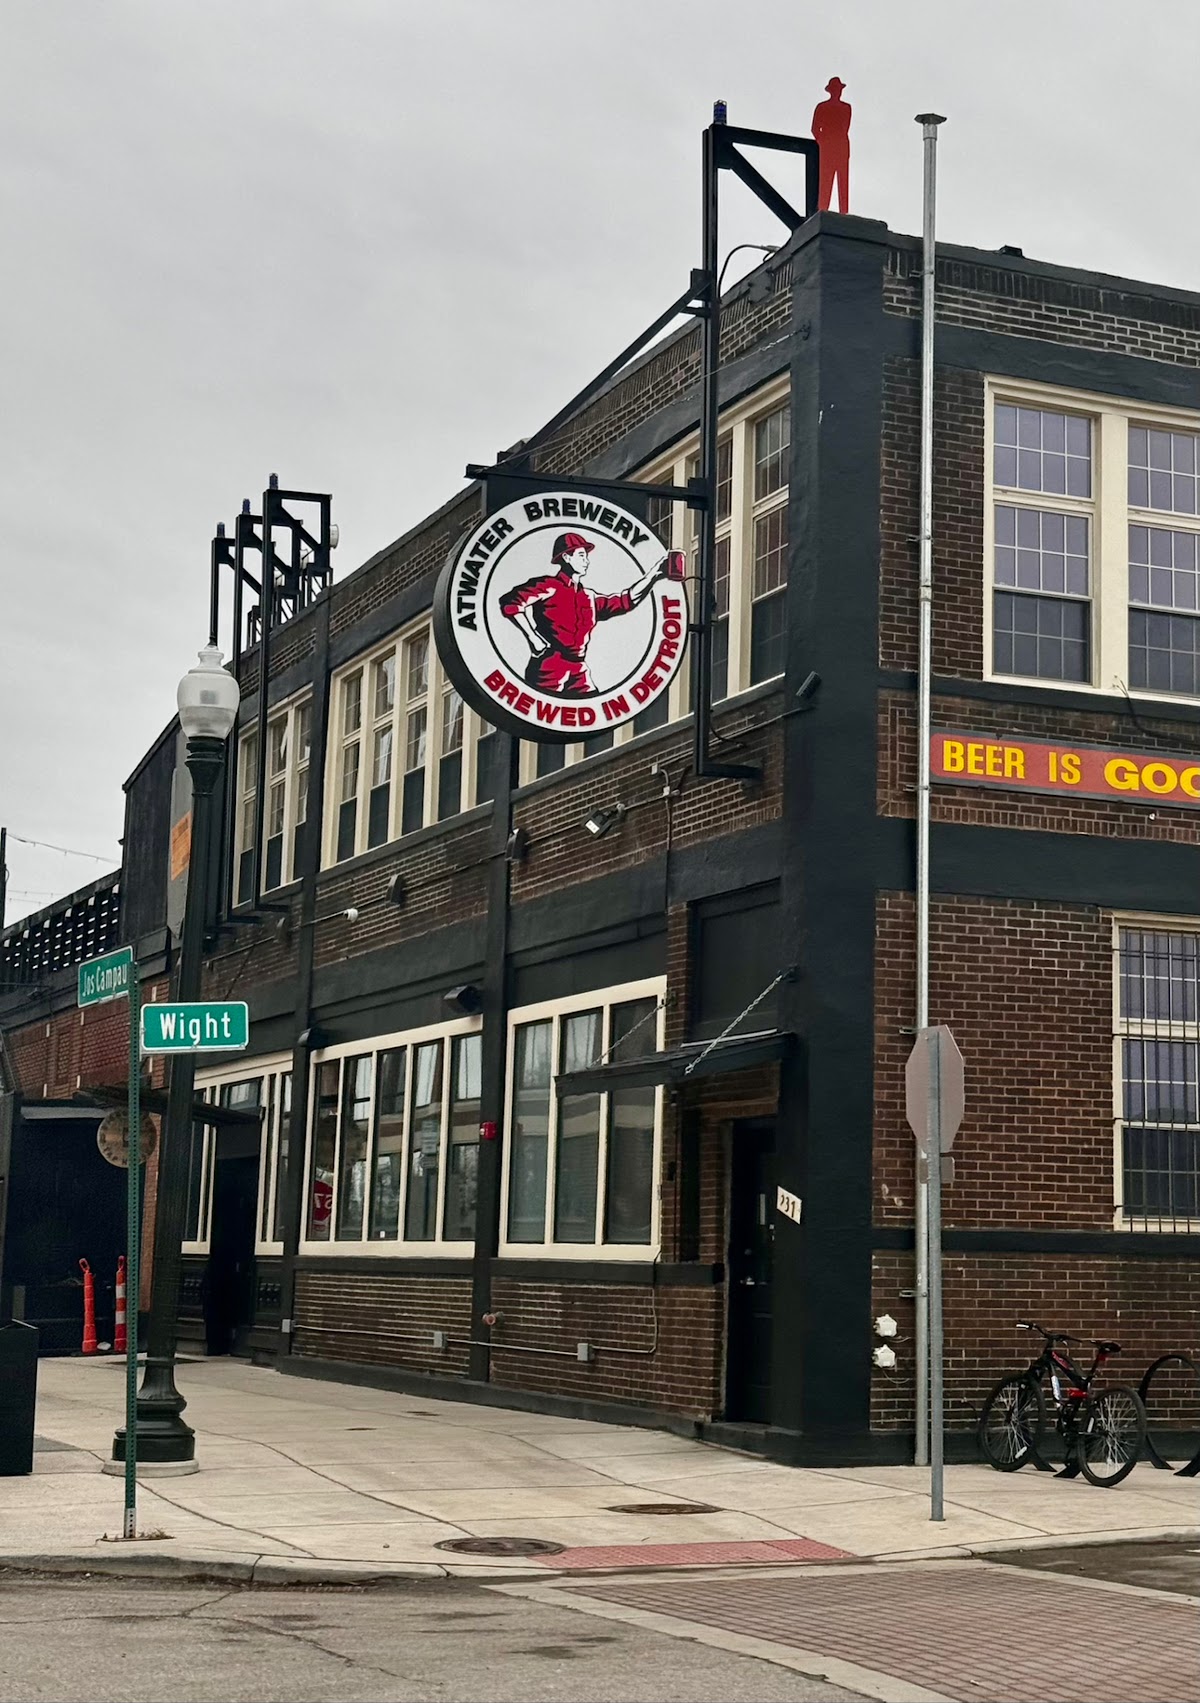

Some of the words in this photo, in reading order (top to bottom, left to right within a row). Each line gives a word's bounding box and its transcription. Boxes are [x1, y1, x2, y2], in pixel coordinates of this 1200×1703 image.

[457, 517, 514, 631] ATWATER
[523, 498, 650, 548] BREWERY
[483, 669, 596, 727] BREWED
[602, 695, 631, 721] IN
[629, 595, 682, 704] DETROIT
[942, 740, 1025, 779] BEER
[1048, 751, 1081, 785] IS
[82, 971, 95, 997] Jos
[96, 962, 128, 992] Campau
[159, 1011, 231, 1046] Wight
